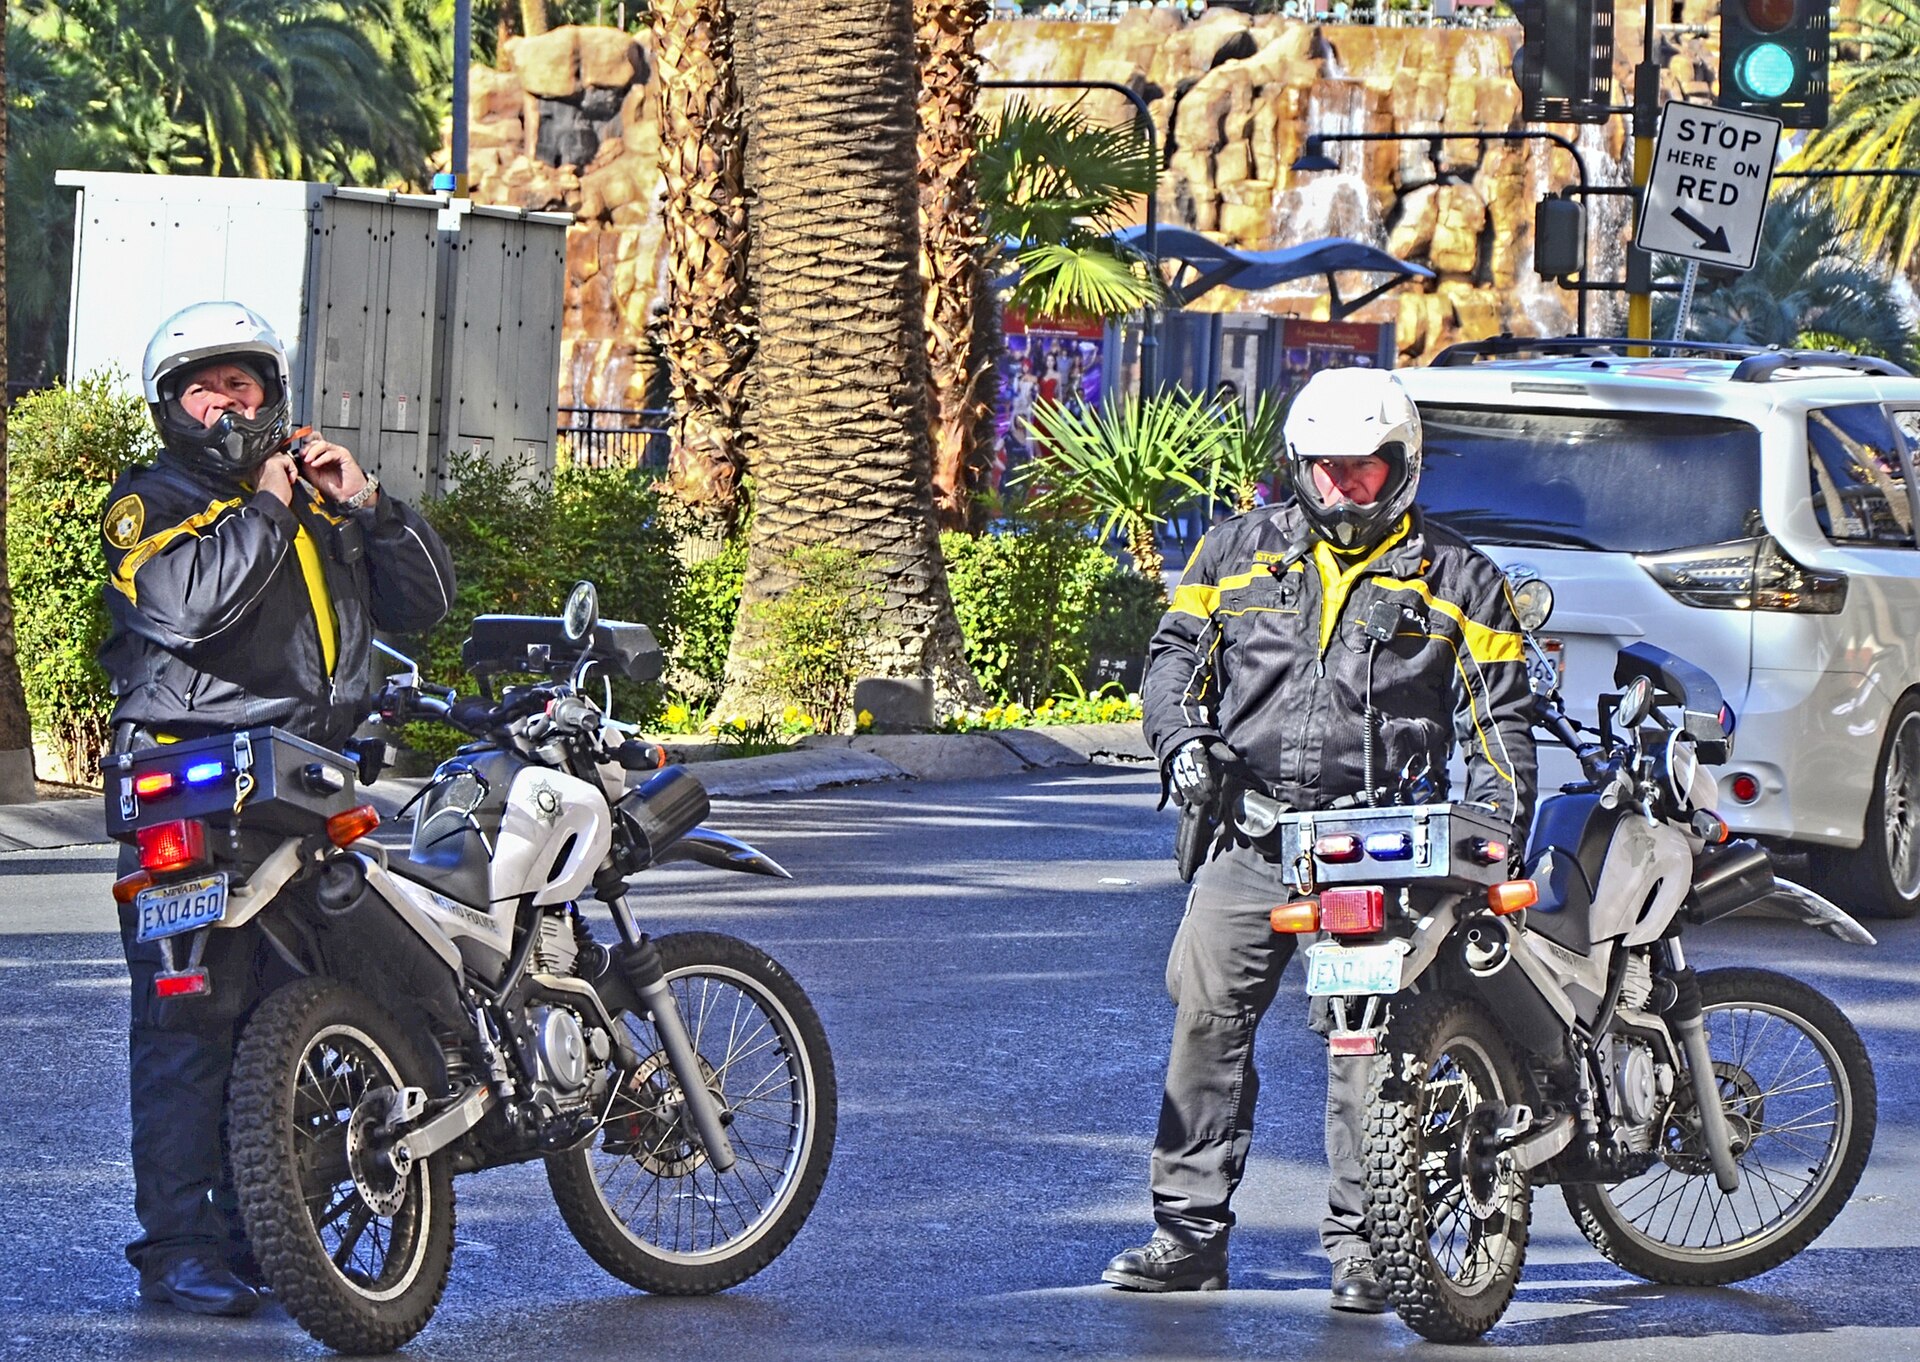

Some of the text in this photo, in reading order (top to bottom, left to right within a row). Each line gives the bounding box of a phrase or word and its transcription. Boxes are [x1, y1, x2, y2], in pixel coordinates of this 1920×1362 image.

[1677, 119, 1762, 152] STOP
[1667, 148, 1760, 179] HERE ON
[1676, 174, 1739, 206] RED
[163, 882, 203, 898] NEVADA
[143, 893, 219, 931] EX0460
[464, 908, 497, 930] POLICE
